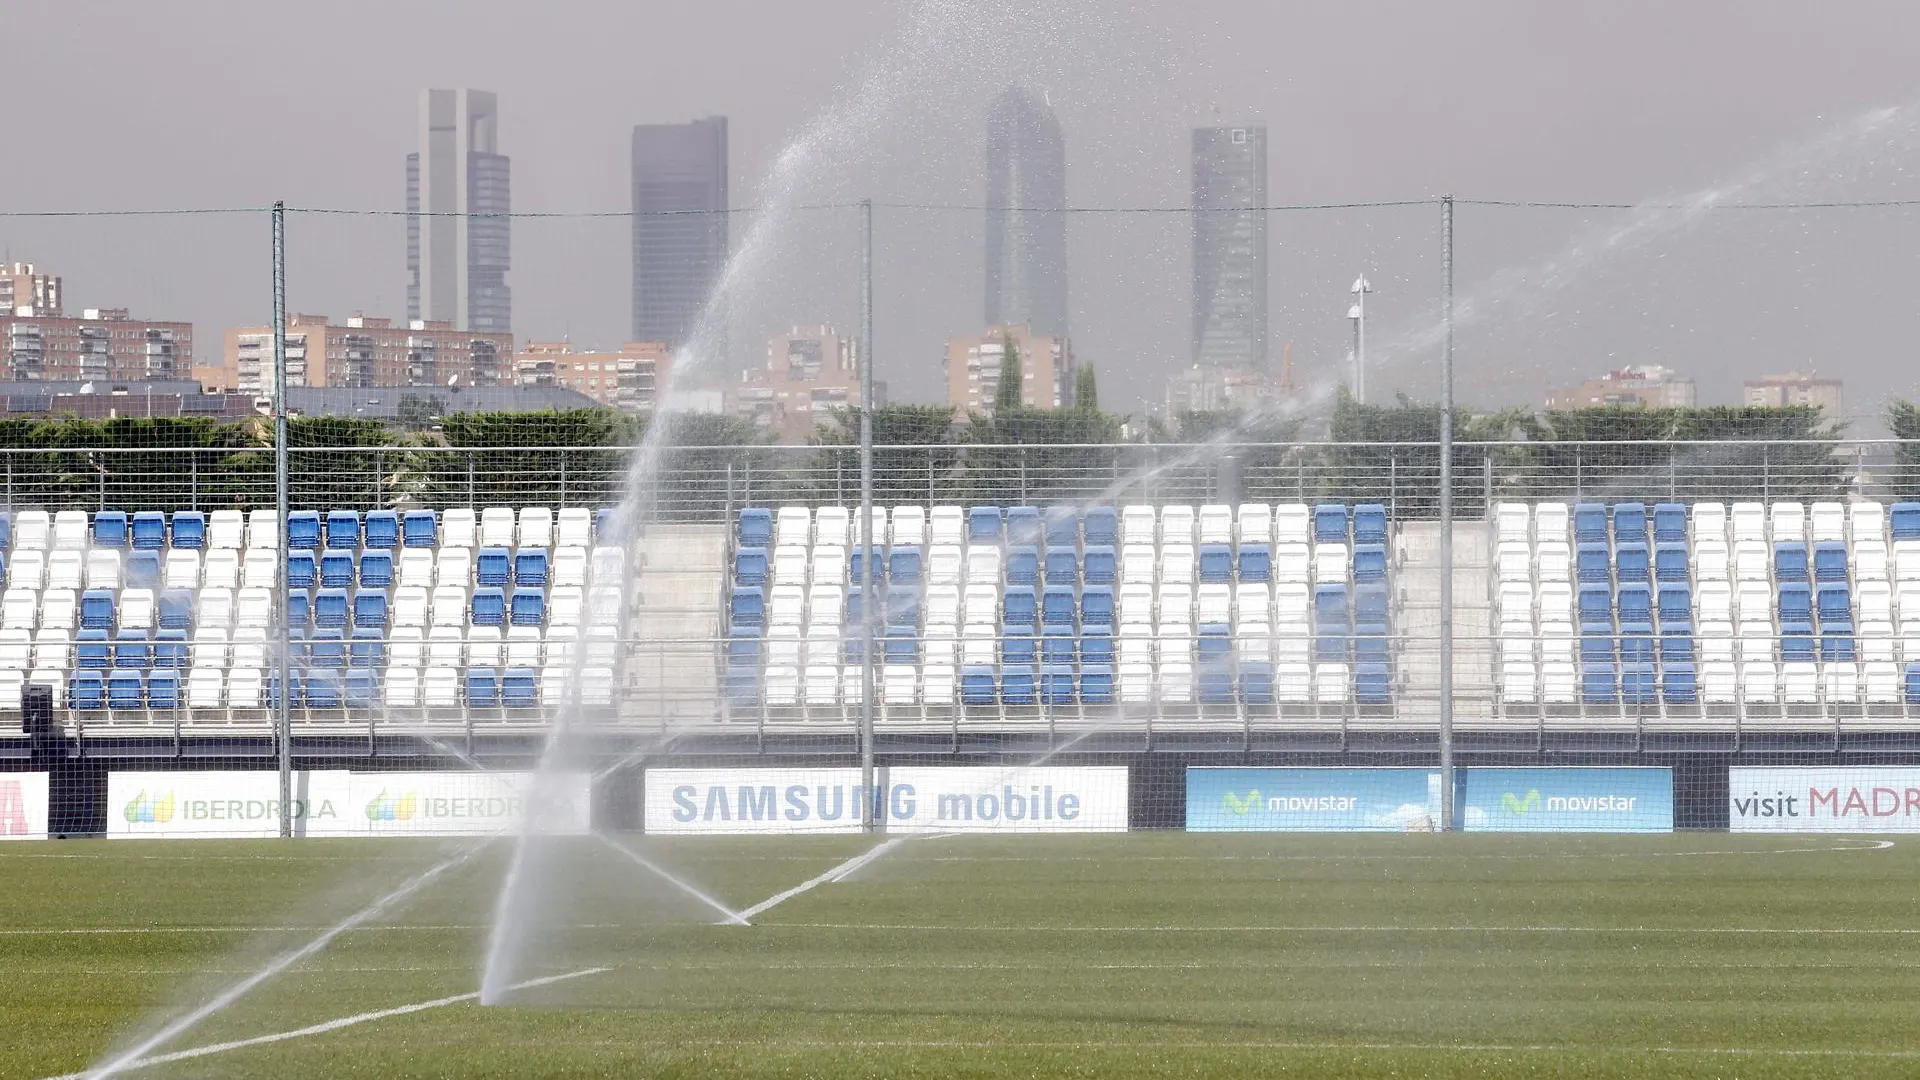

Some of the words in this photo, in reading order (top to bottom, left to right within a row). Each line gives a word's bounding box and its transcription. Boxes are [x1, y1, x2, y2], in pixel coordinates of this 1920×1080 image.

[183, 799, 337, 820] IBERDROLA
[424, 797, 572, 818] IBERDR
[672, 784, 917, 823] SAMSUNG
[937, 784, 1080, 821] mobile
[1268, 794, 1357, 811] movistar
[1547, 794, 1637, 811] movistar
[1734, 790, 1799, 817] visit
[1809, 787, 1920, 817] MADR
